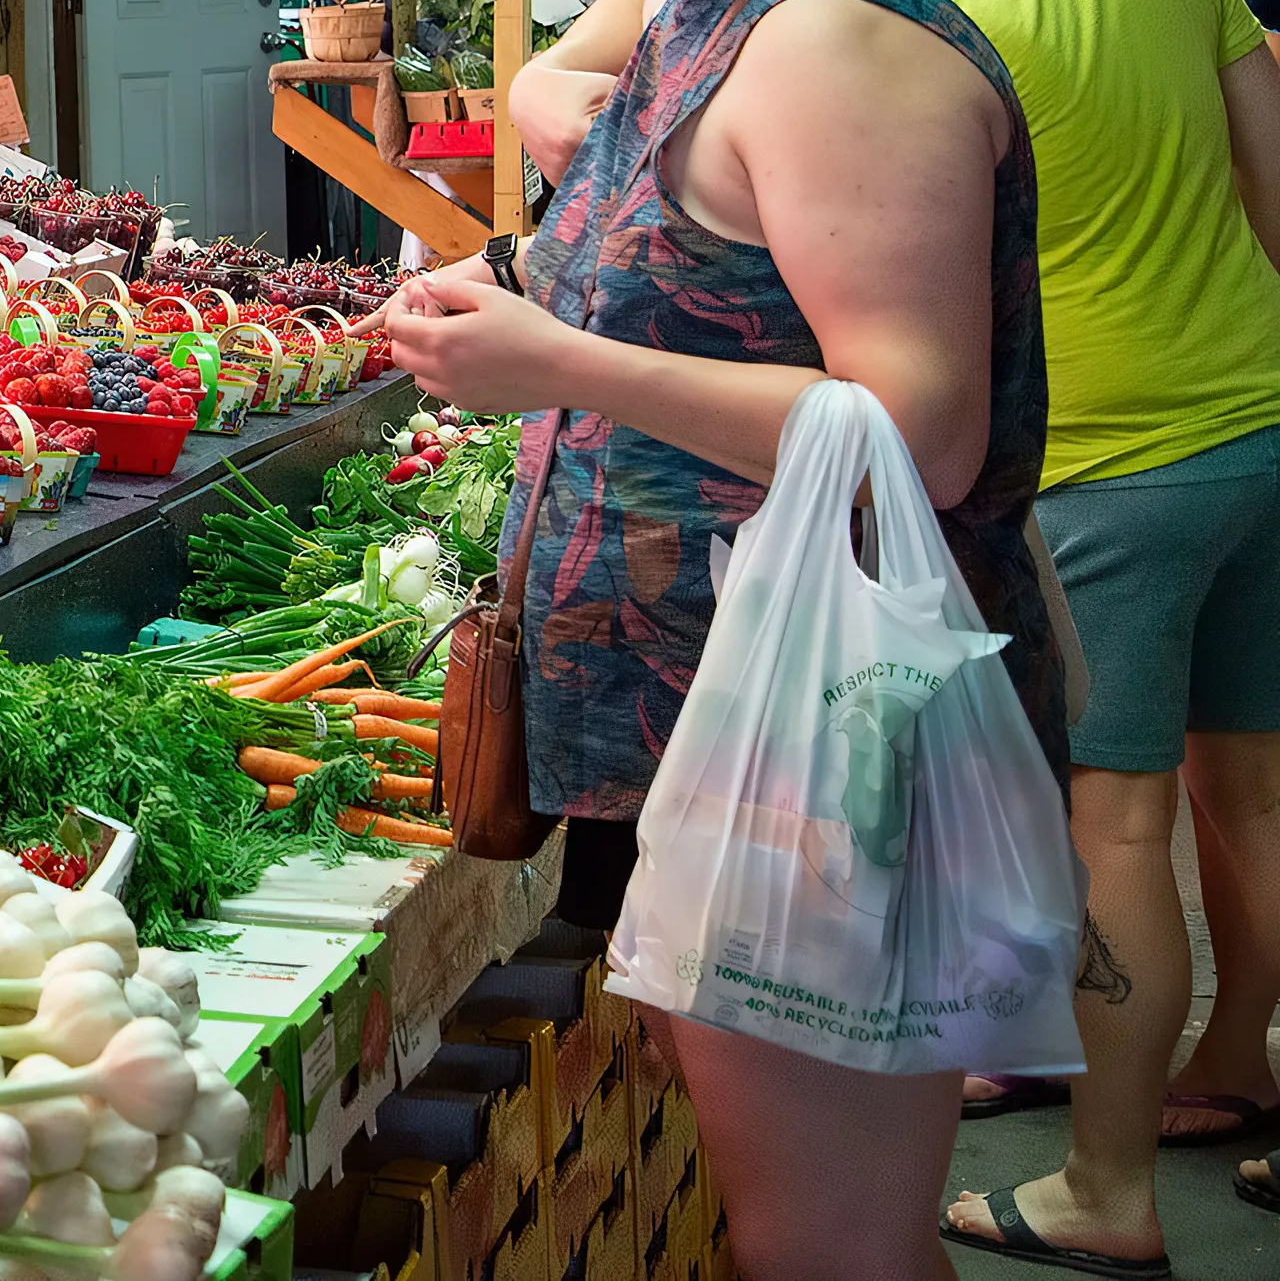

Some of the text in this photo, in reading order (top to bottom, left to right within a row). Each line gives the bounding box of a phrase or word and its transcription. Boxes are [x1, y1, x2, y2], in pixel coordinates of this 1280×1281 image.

[904, 665, 943, 694] THE
[762, 978, 848, 1016] REUSABLE
[744, 996, 781, 1019] 40%
[783, 1007, 870, 1044] RECYCLED
